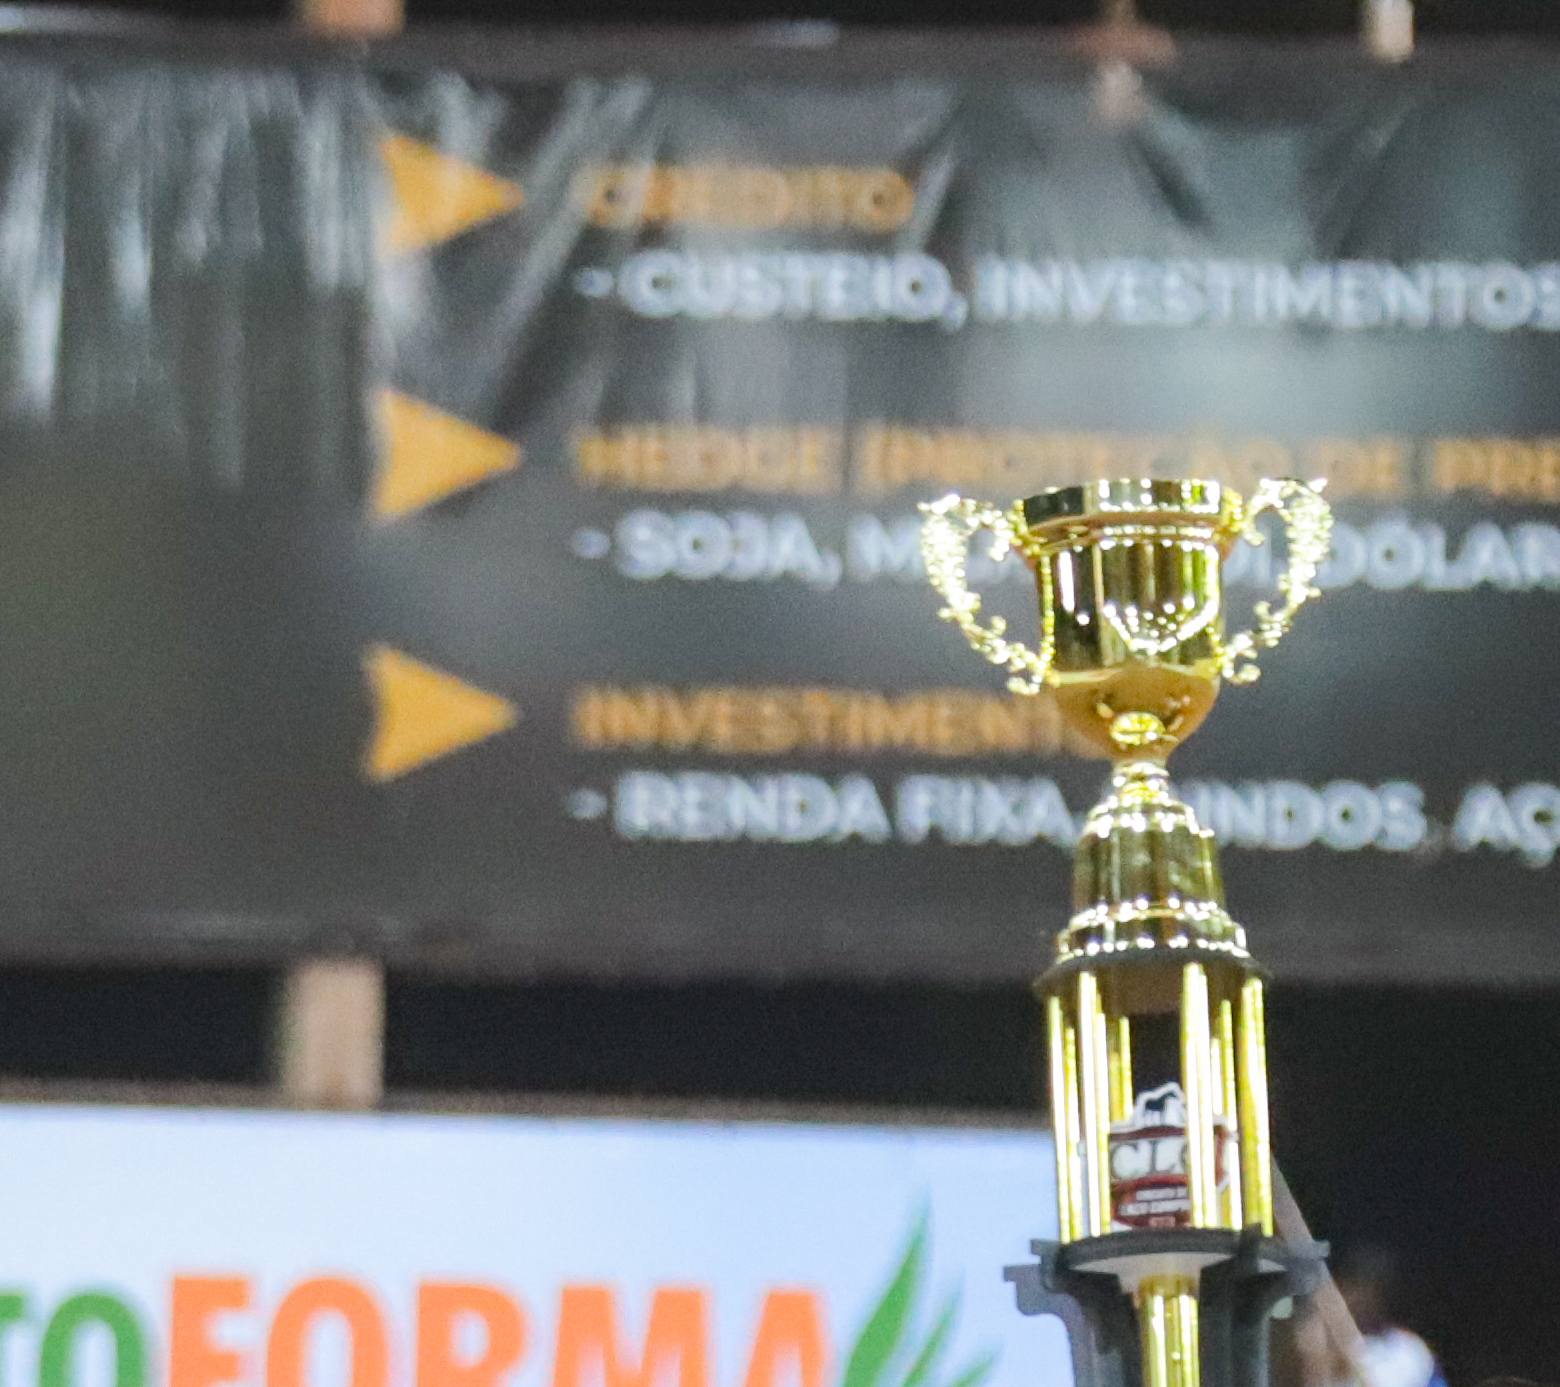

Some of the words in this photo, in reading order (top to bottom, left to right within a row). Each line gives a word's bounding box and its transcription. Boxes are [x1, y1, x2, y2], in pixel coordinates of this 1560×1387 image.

[618, 249, 968, 332] CUSTEIO,
[614, 509, 842, 592] SOJA,
[613, 768, 893, 846] RENDA
